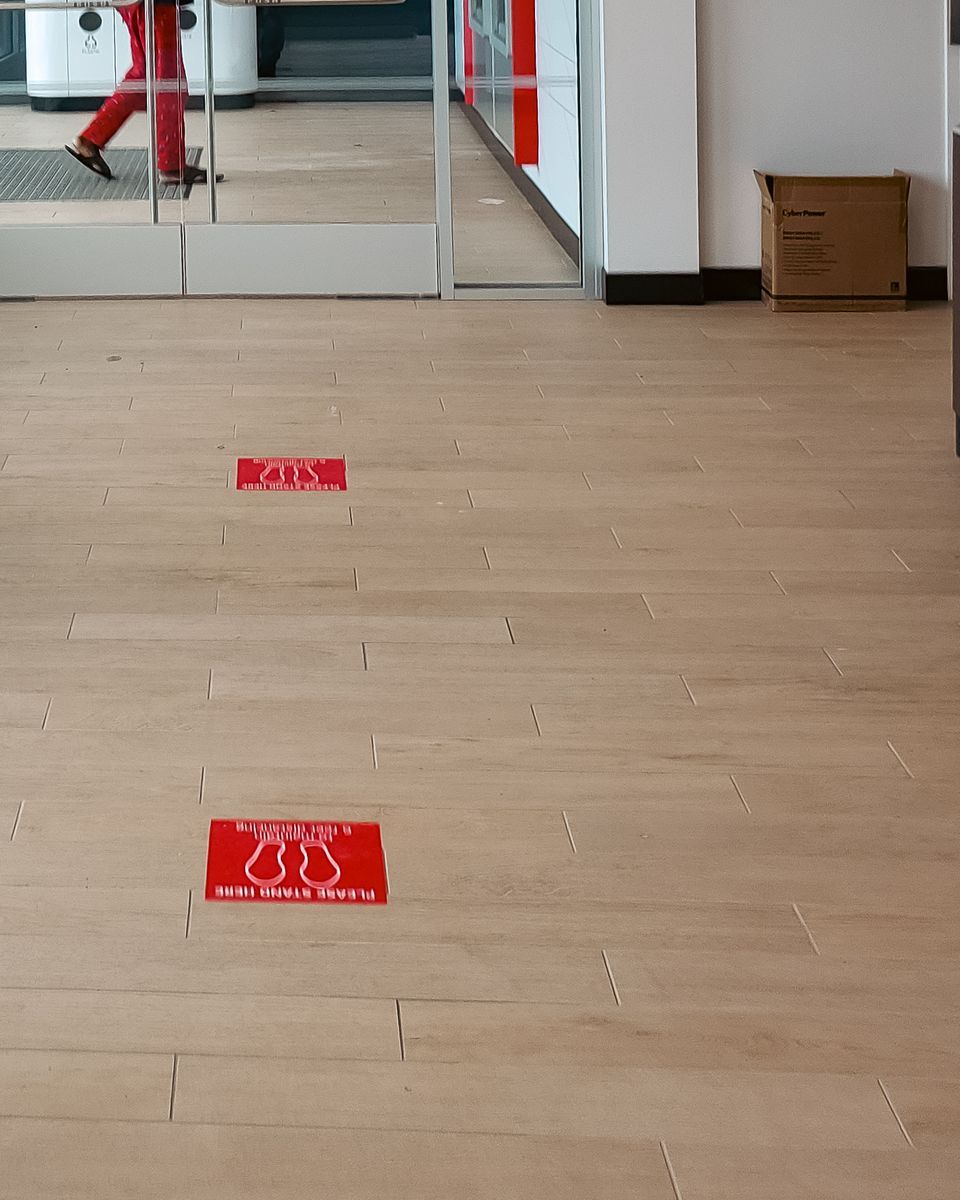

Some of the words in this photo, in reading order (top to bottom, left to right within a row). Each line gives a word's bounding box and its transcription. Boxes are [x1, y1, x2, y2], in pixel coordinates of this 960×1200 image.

[215, 885, 255, 898] HERE
[259, 885, 312, 899] STAND
[317, 886, 376, 901] PLEASE
